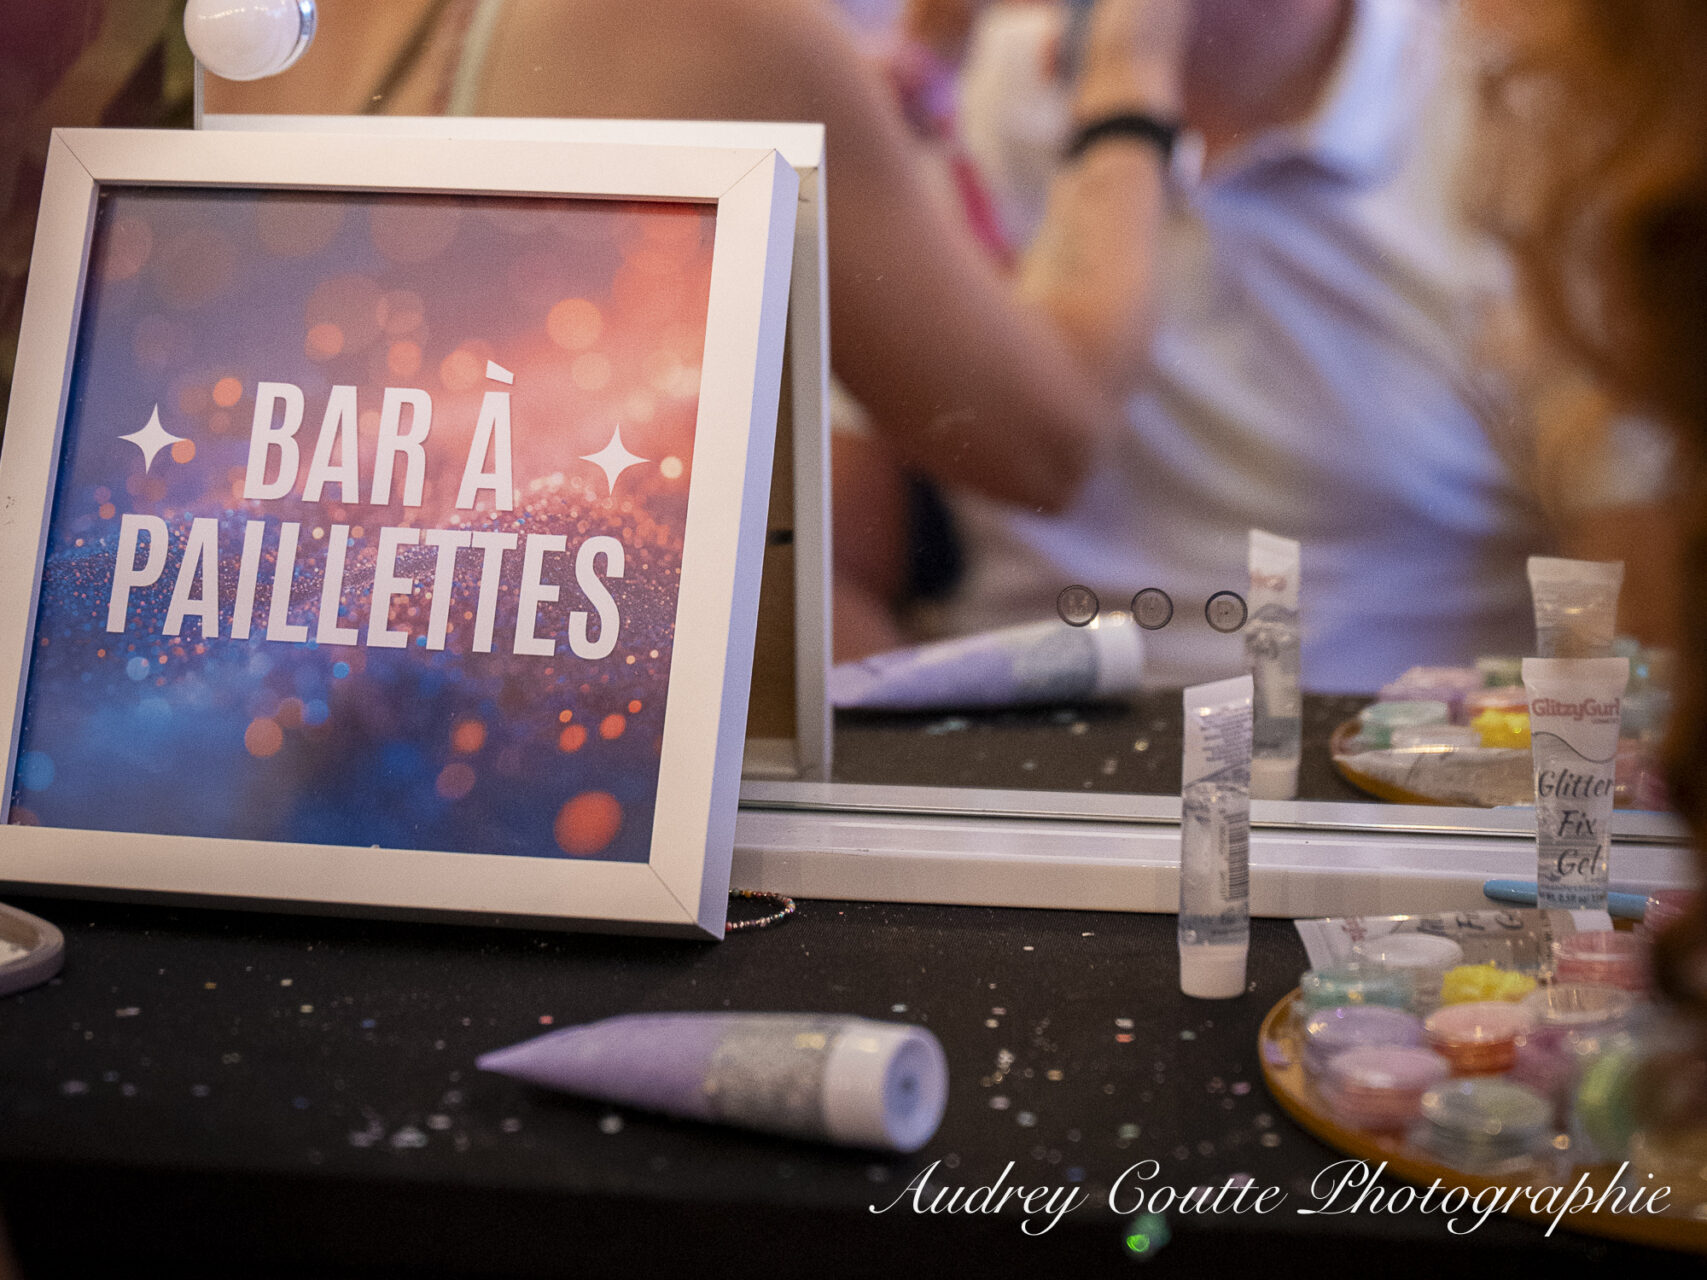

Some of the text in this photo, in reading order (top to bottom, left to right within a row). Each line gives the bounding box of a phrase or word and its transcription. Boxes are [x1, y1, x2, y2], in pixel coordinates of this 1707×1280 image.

[242, 359, 514, 512] BAR À
[106, 513, 626, 661] PAILLETTES
[1531, 697, 1620, 721] GlitzyGurl
[1537, 768, 1613, 798] Glitter
[1557, 809, 1597, 837] Fix
[1557, 844, 1602, 875] Gel
